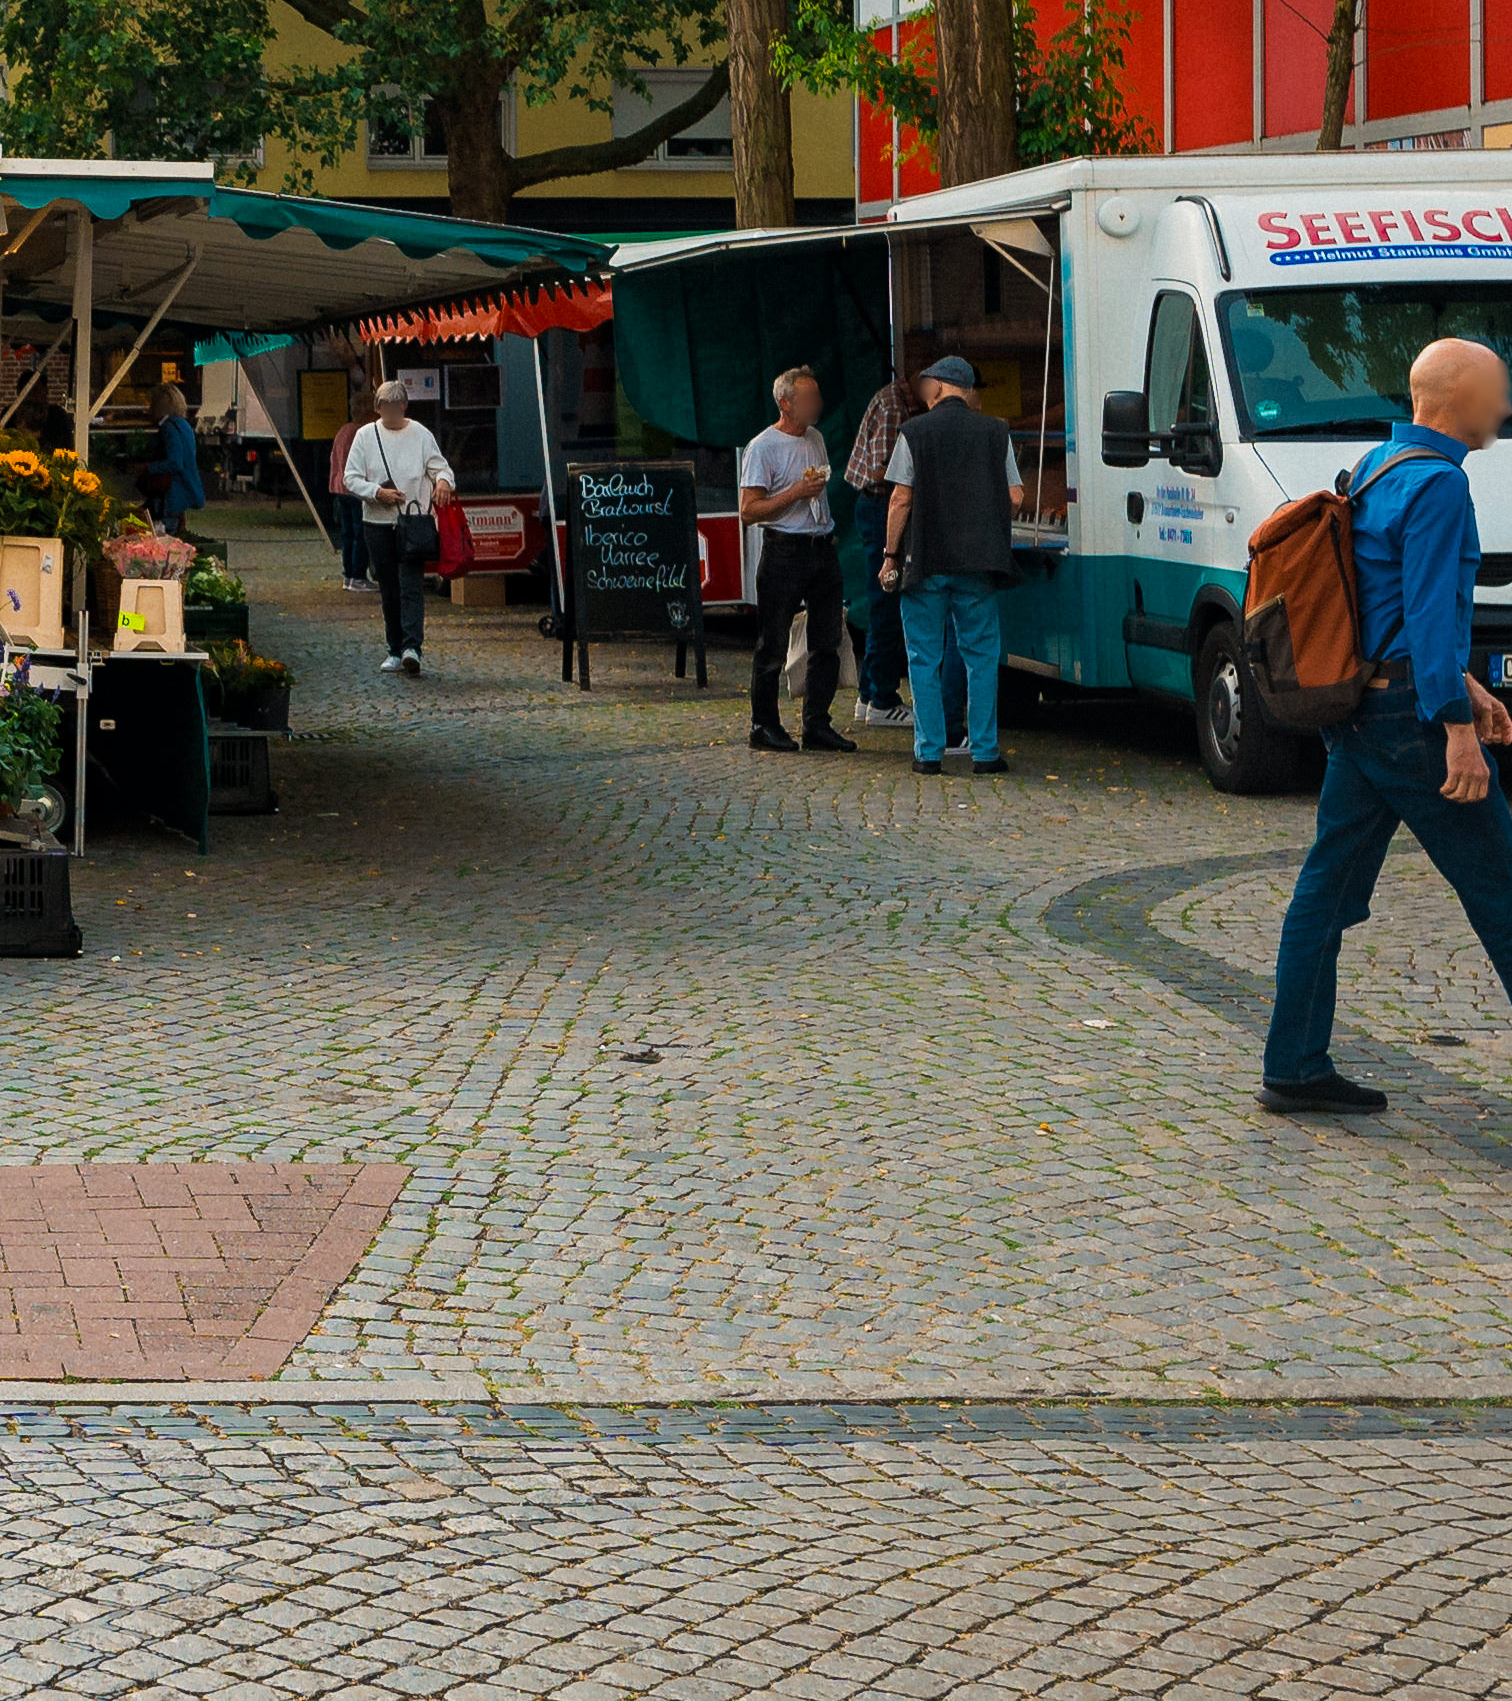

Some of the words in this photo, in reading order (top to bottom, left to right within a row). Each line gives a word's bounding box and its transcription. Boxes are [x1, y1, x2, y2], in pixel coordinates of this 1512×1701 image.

[1313, 248, 1374, 262] Helmut
[1378, 247, 1464, 259] Stanislaus
[581, 487, 674, 518] Bratwurst
